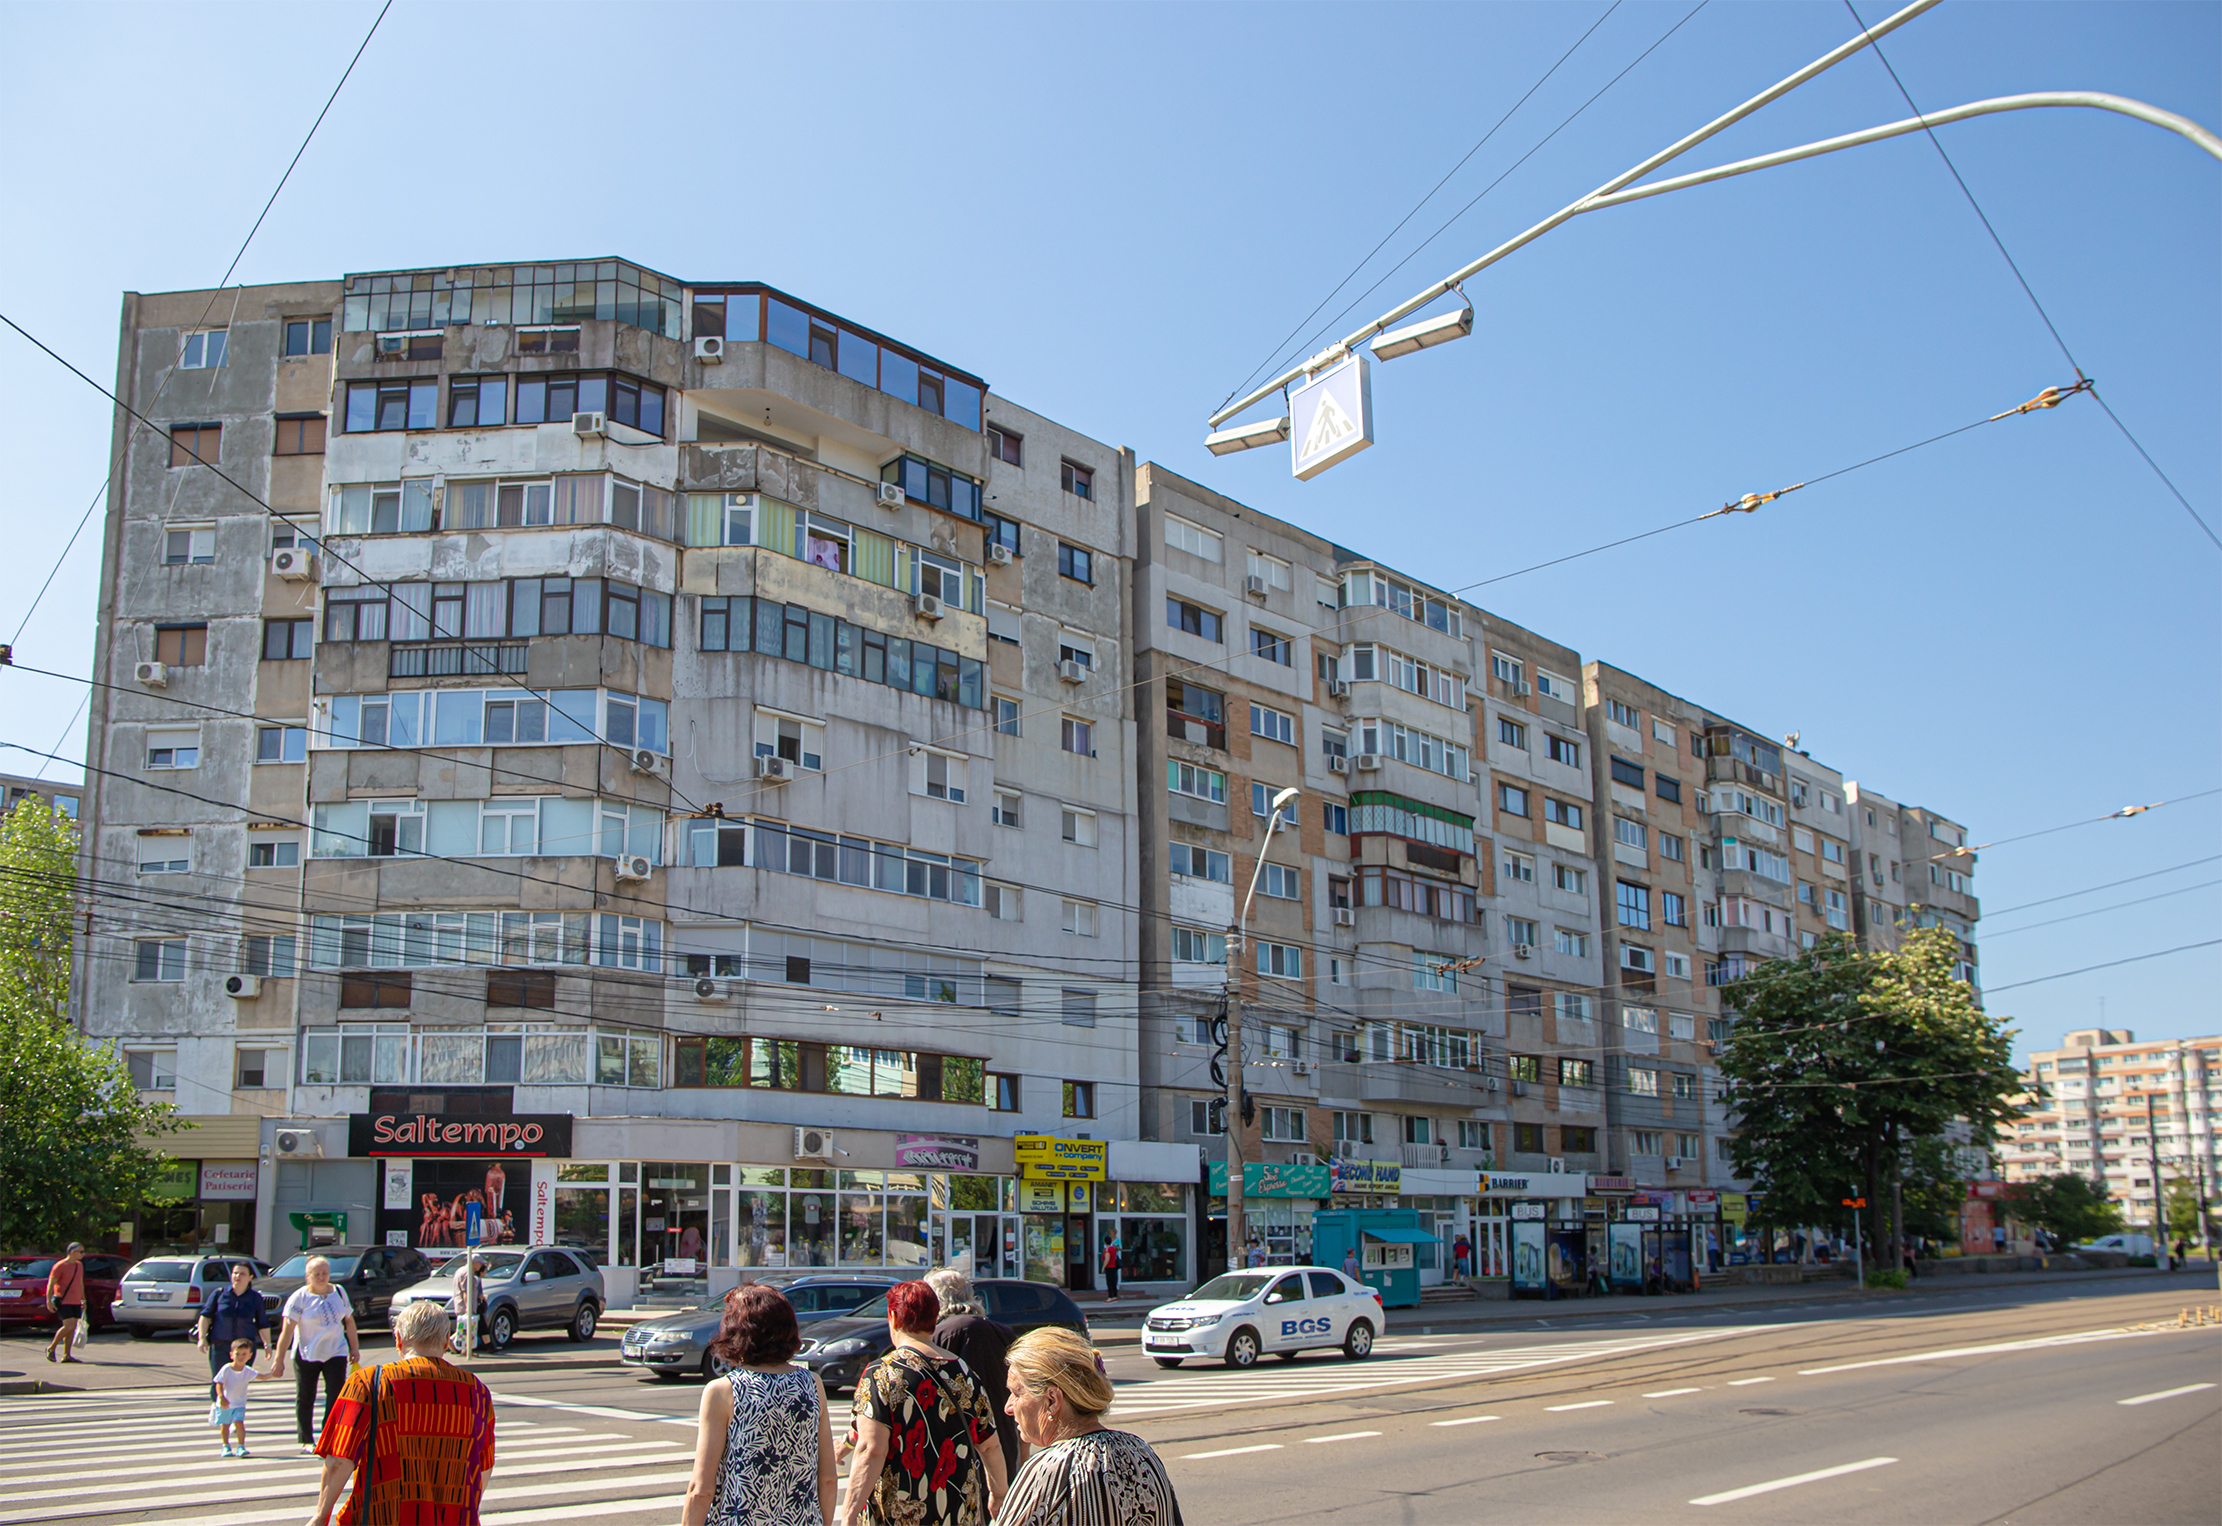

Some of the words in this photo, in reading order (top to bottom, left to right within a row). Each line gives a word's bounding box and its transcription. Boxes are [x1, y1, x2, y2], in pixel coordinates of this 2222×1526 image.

[374, 1114, 544, 1150] Saltempo
[203, 1169, 256, 1179] Cofetarie
[1338, 1164, 1373, 1180] SECOND
[1375, 1166, 1400, 1182] HAND
[205, 1181, 254, 1191] Patiserie
[1491, 1178, 1529, 1189] BARRIER
[536, 1181, 548, 1246] Saltempo
[1517, 1206, 1539, 1217] BUS
[1632, 1209, 1653, 1219] BUS
[1281, 1317, 1331, 1336] BGS
